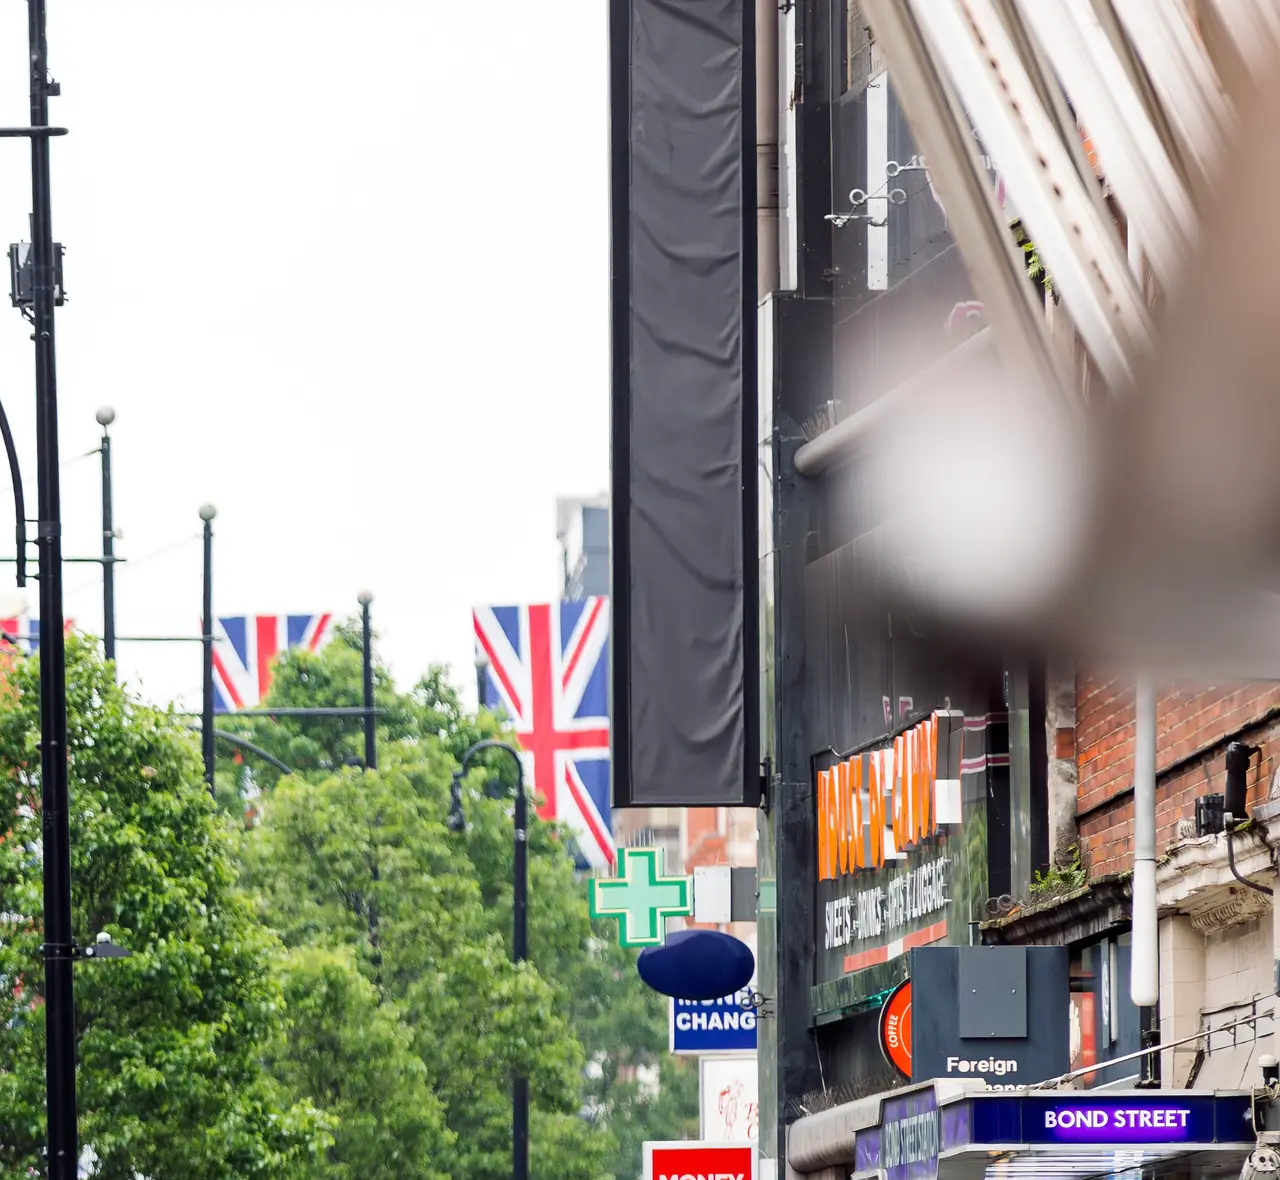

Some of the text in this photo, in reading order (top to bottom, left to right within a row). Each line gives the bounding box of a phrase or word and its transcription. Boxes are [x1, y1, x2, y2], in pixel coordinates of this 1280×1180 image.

[676, 1011, 756, 1031] CHANG
[887, 1014, 899, 1048] COFFEE
[946, 1056, 1018, 1076] Foreign
[1044, 1109, 1191, 1129] BOND STREET
